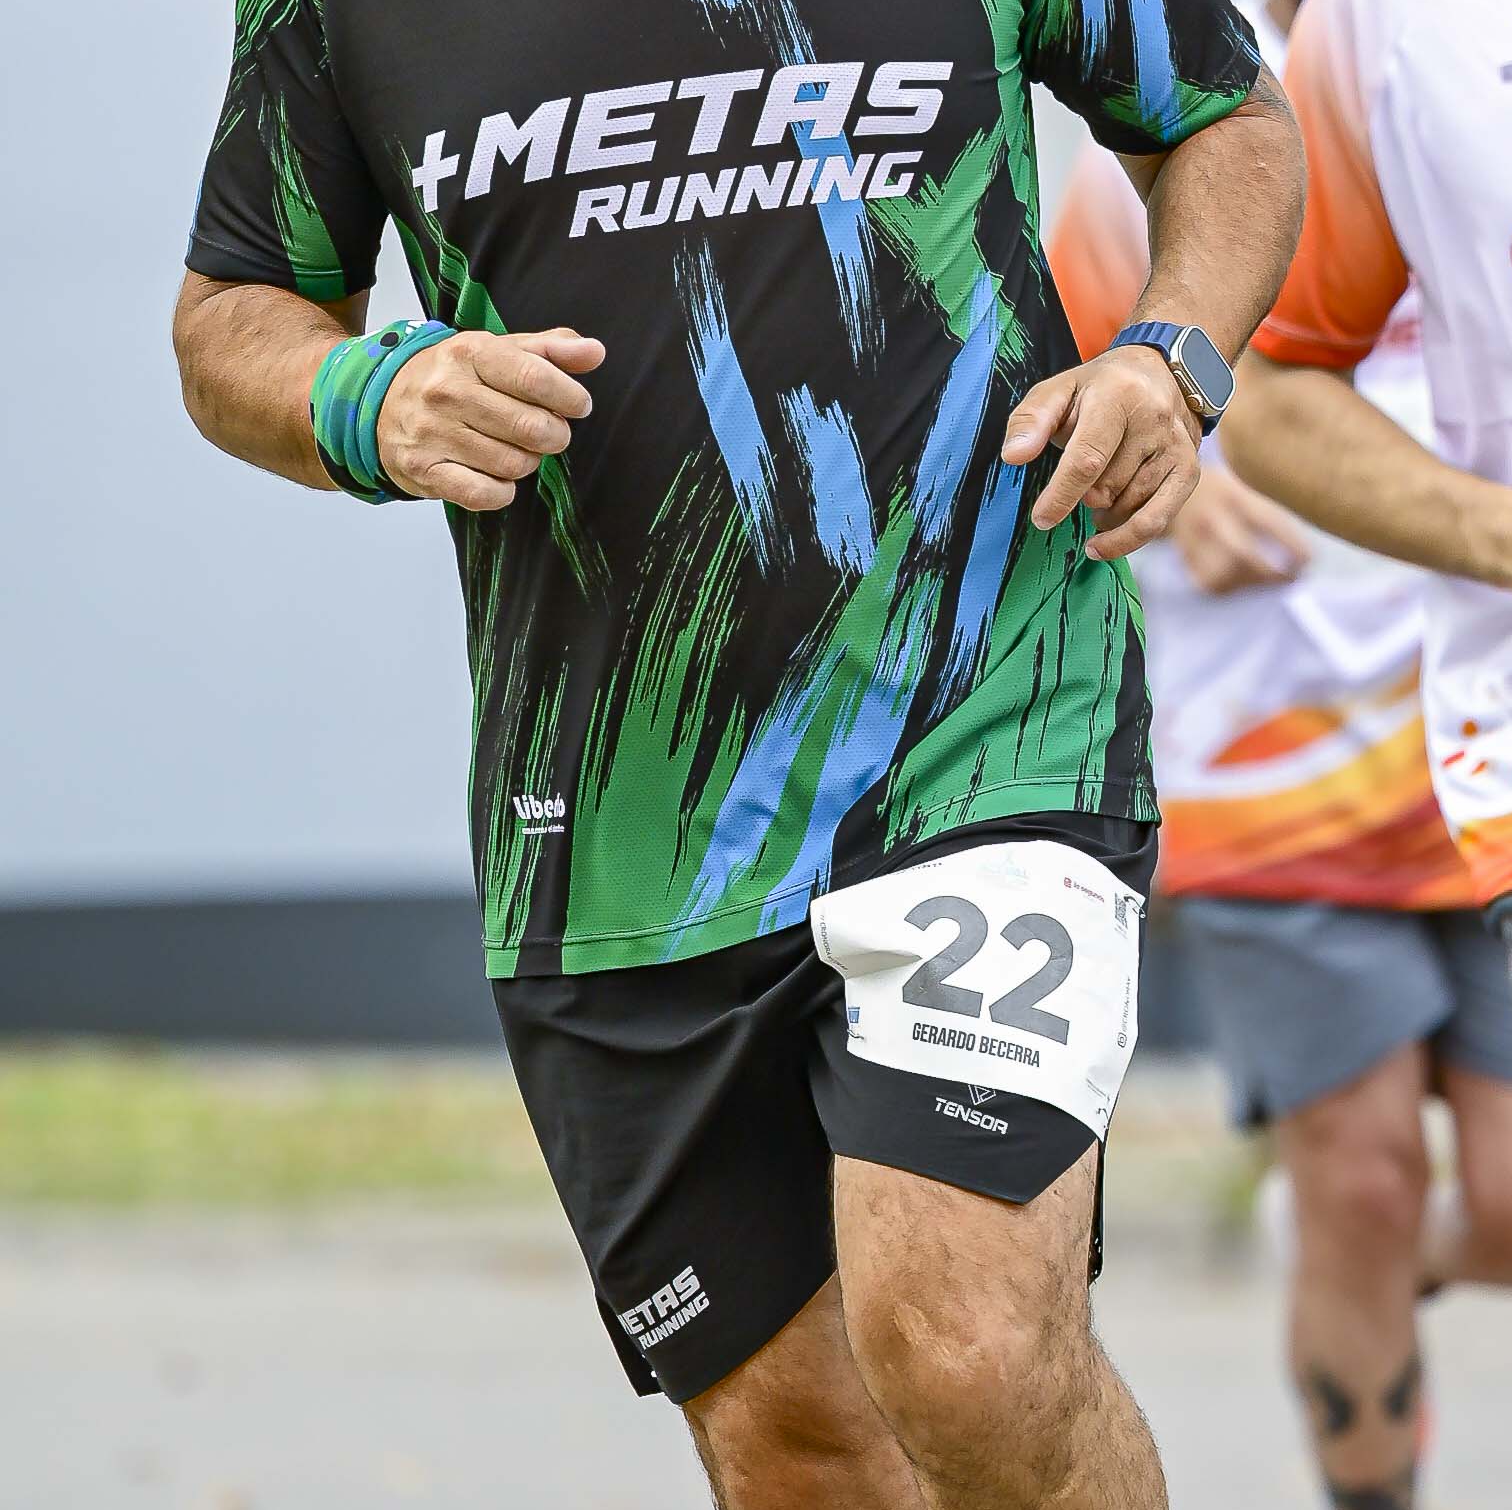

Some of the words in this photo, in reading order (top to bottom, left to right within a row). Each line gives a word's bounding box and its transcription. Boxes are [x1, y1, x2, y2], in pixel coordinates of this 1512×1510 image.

[569, 151, 922, 238] RUNNING
[902, 896, 1074, 1045] 22
[913, 1022, 976, 1051] GERARDO
[979, 1036, 1041, 1068] BECERRA
[935, 1097, 1009, 1134] TENSOR
[638, 1291, 710, 1350] RUNNING
